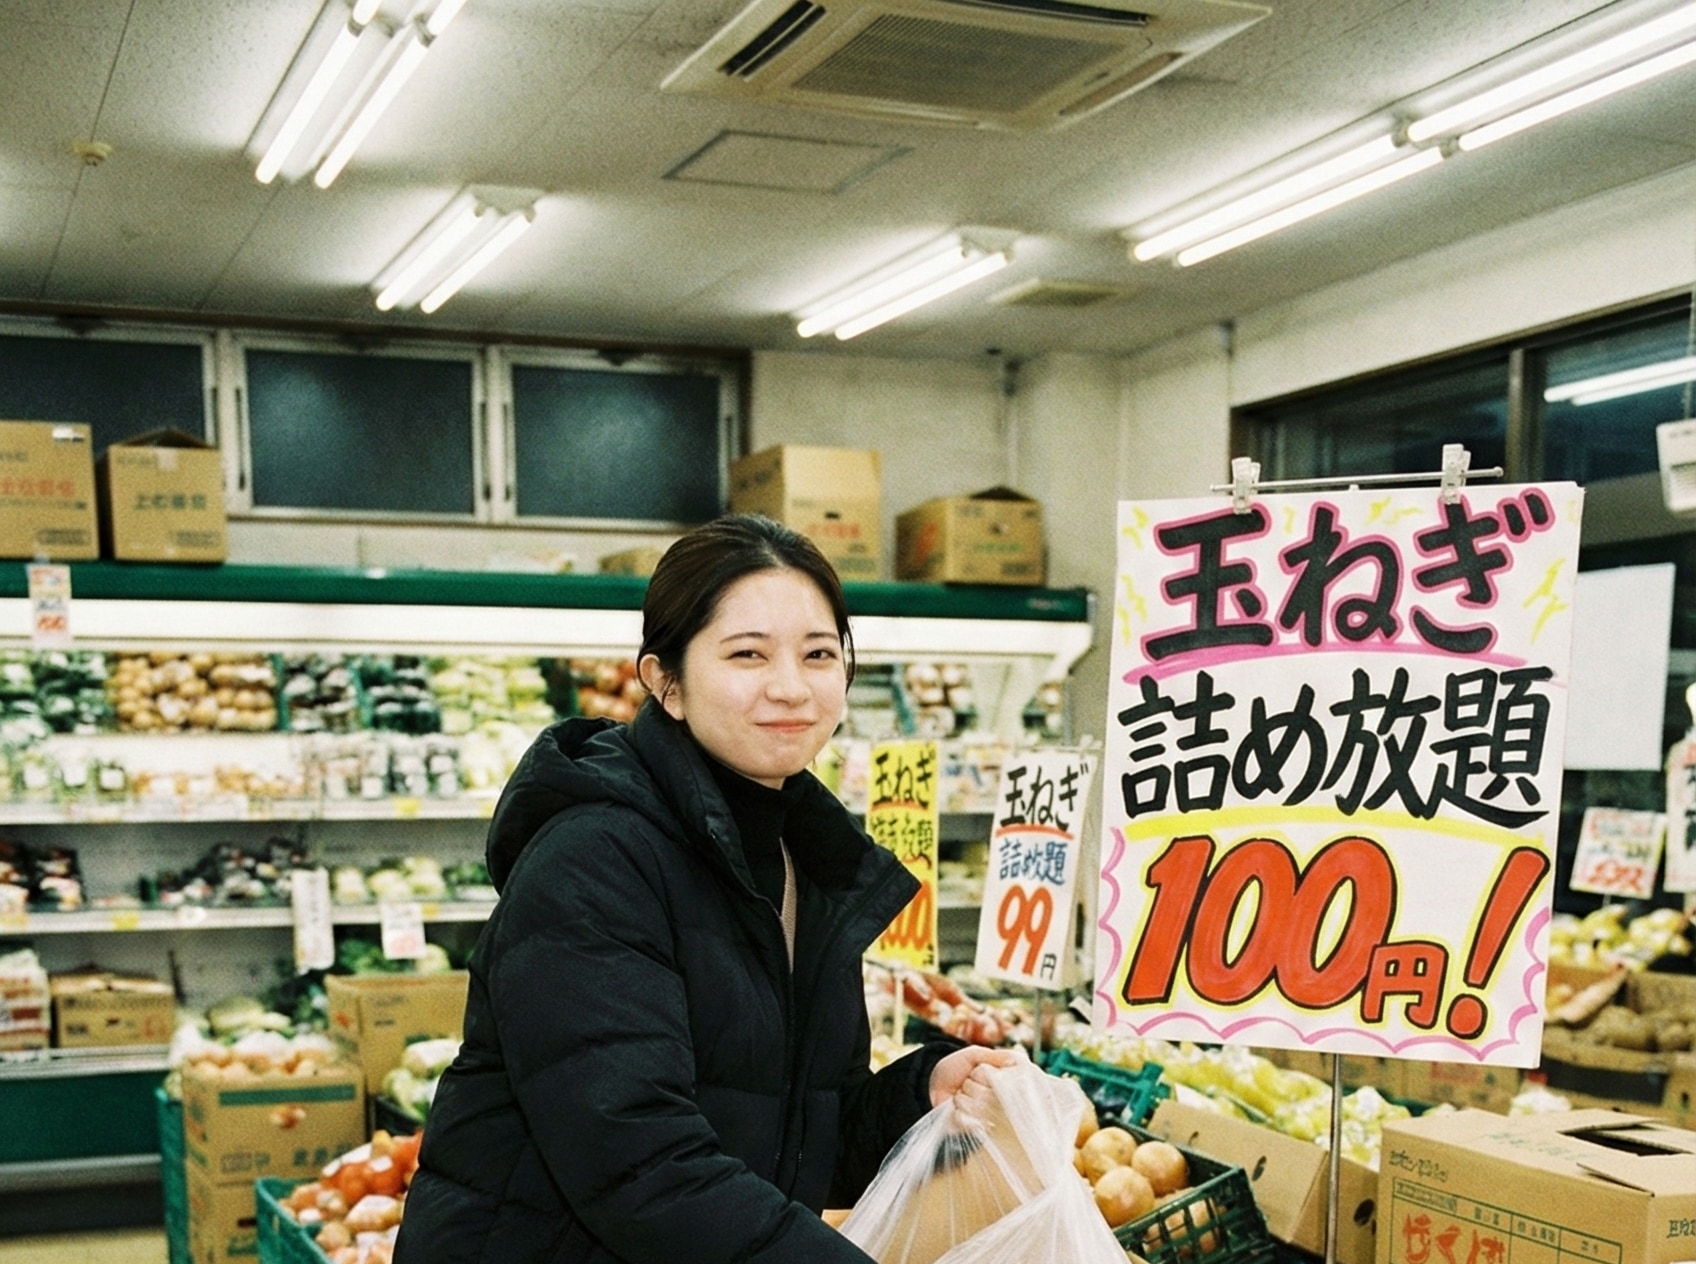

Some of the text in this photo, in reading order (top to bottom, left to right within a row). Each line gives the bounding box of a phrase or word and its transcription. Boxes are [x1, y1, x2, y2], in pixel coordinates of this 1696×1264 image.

[1143, 489, 1553, 660] 玉ねぎ
[1000, 763, 1089, 832] 玉ねぎ
[1118, 666, 1552, 828] 詰め放題
